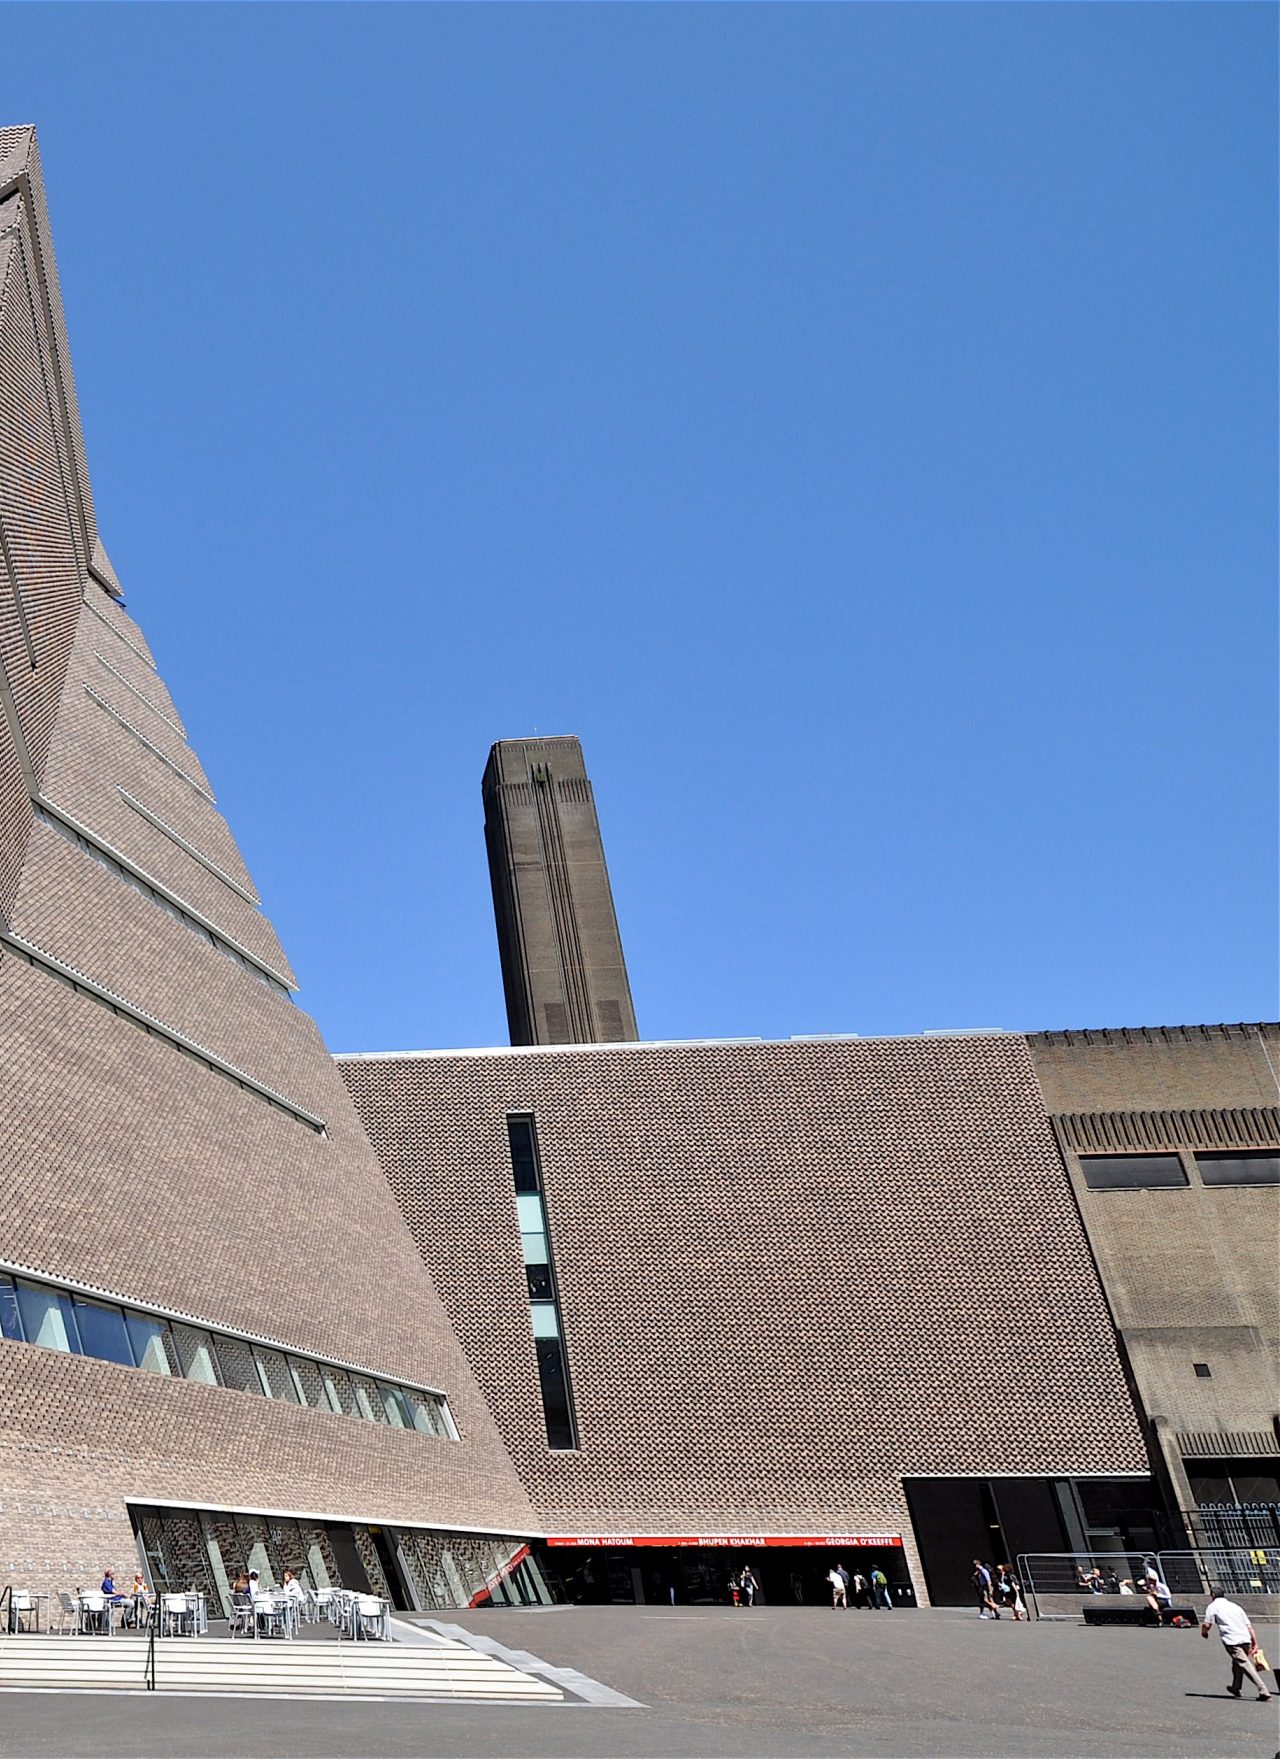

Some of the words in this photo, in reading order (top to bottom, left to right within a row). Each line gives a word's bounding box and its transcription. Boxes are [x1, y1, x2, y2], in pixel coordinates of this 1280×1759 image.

[698, 1538, 728, 1546] BHUPEN
[729, 1538, 765, 1546] KHAKHAR
[825, 1538, 858, 1546] GEORGIA
[860, 1538, 893, 1546] O'KEEFFE
